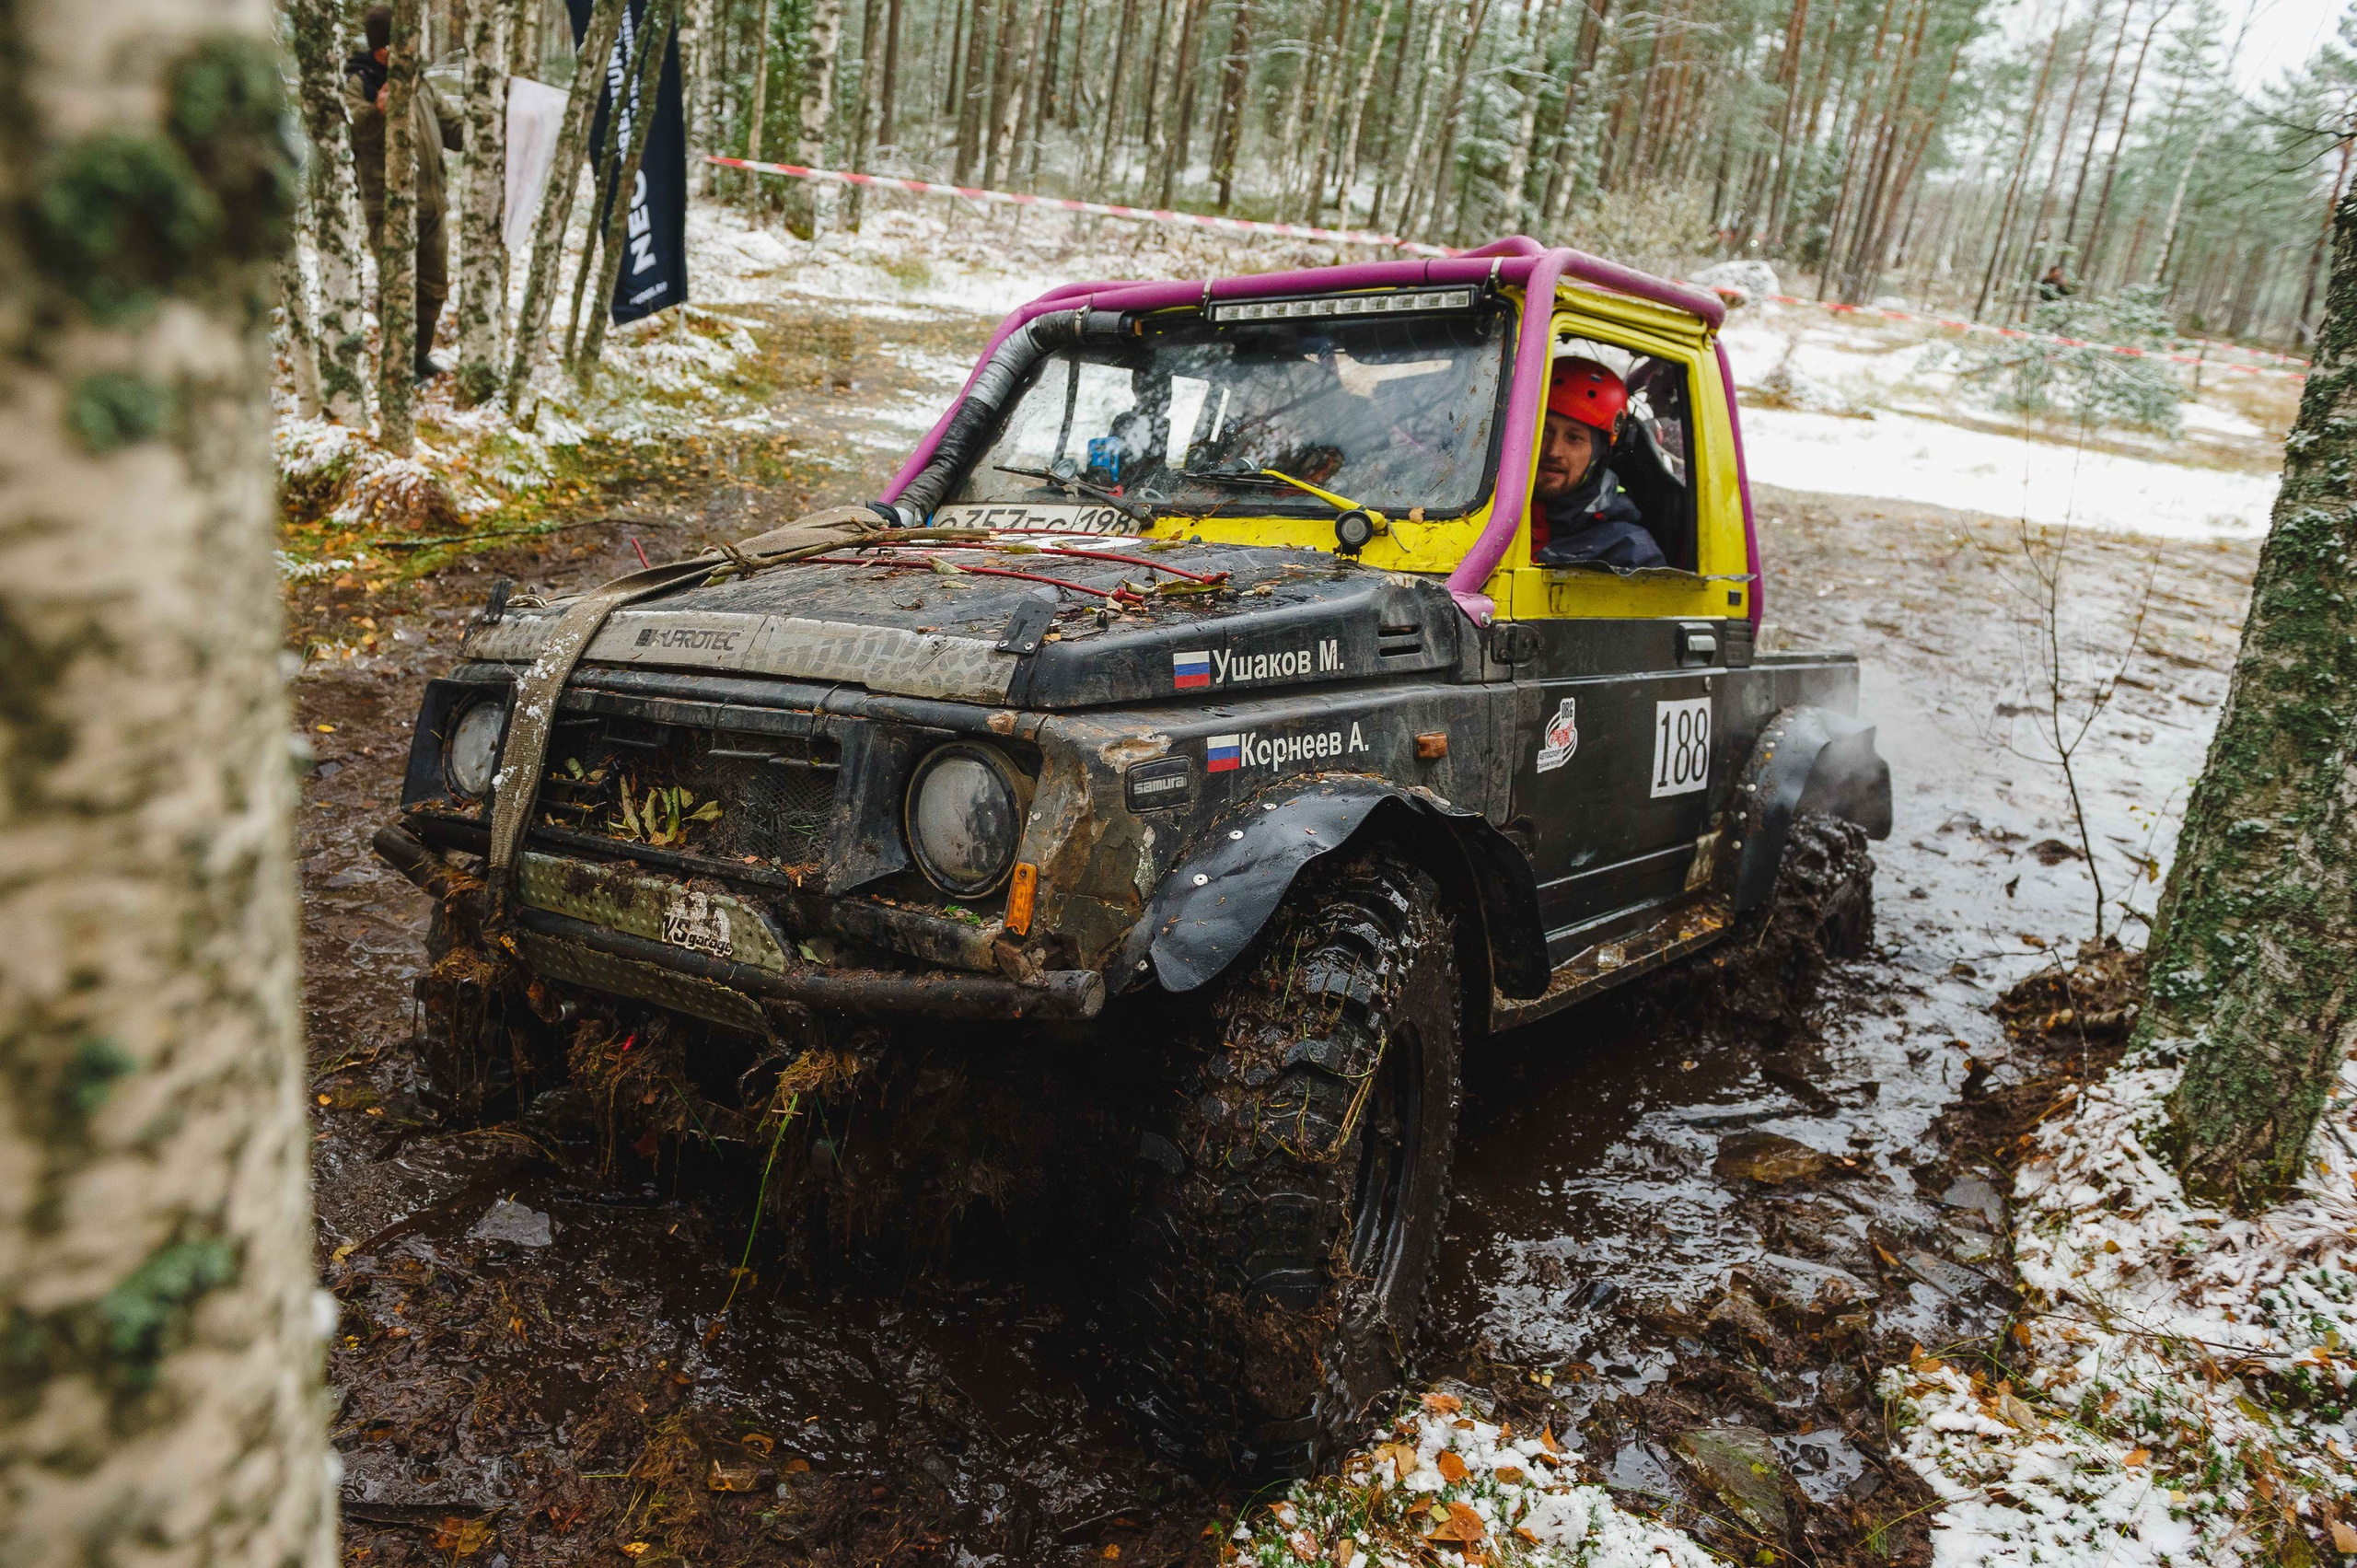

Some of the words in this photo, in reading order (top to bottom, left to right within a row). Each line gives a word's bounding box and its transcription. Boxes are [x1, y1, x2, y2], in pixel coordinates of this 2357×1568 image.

[1212, 648, 1311, 684] Ушаков
[1318, 639, 1345, 673] М.
[1240, 731, 1342, 772] Корнеев
[1348, 721, 1370, 752] А.
[1657, 707, 1708, 788] 188
[1133, 776, 1188, 795] samurai
[688, 934, 733, 955] garage
